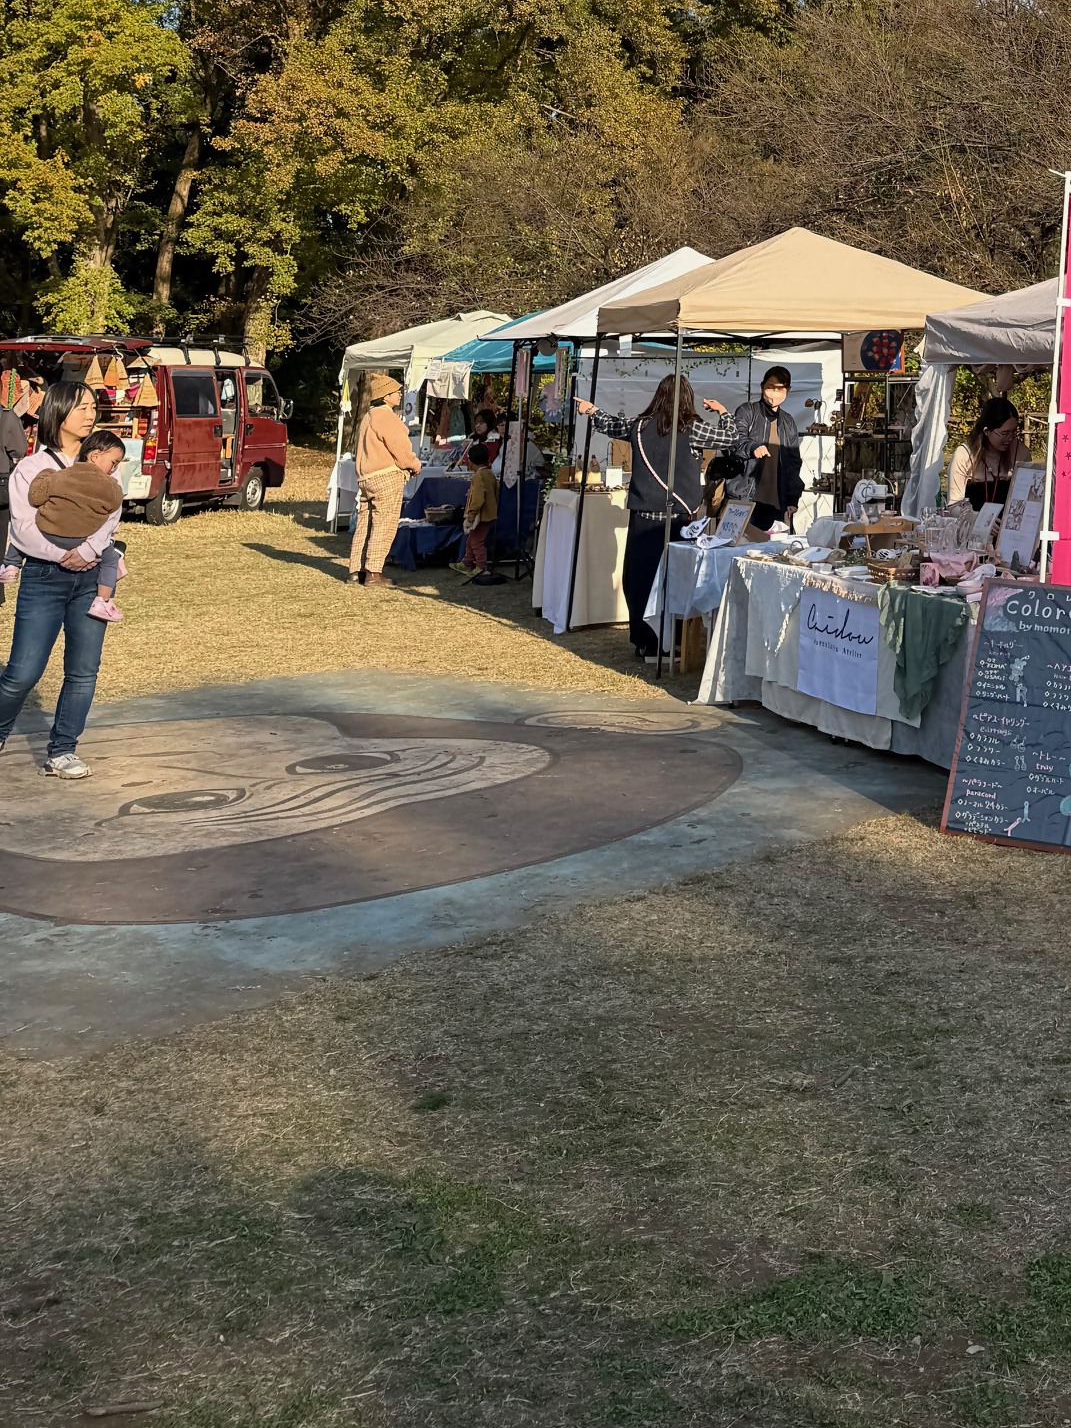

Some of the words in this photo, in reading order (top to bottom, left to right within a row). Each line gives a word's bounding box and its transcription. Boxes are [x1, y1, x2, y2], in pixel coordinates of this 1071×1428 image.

[1019, 621, 1032, 632] by
[1036, 763, 1054, 772] tray
[966, 789, 996, 799] paracord
